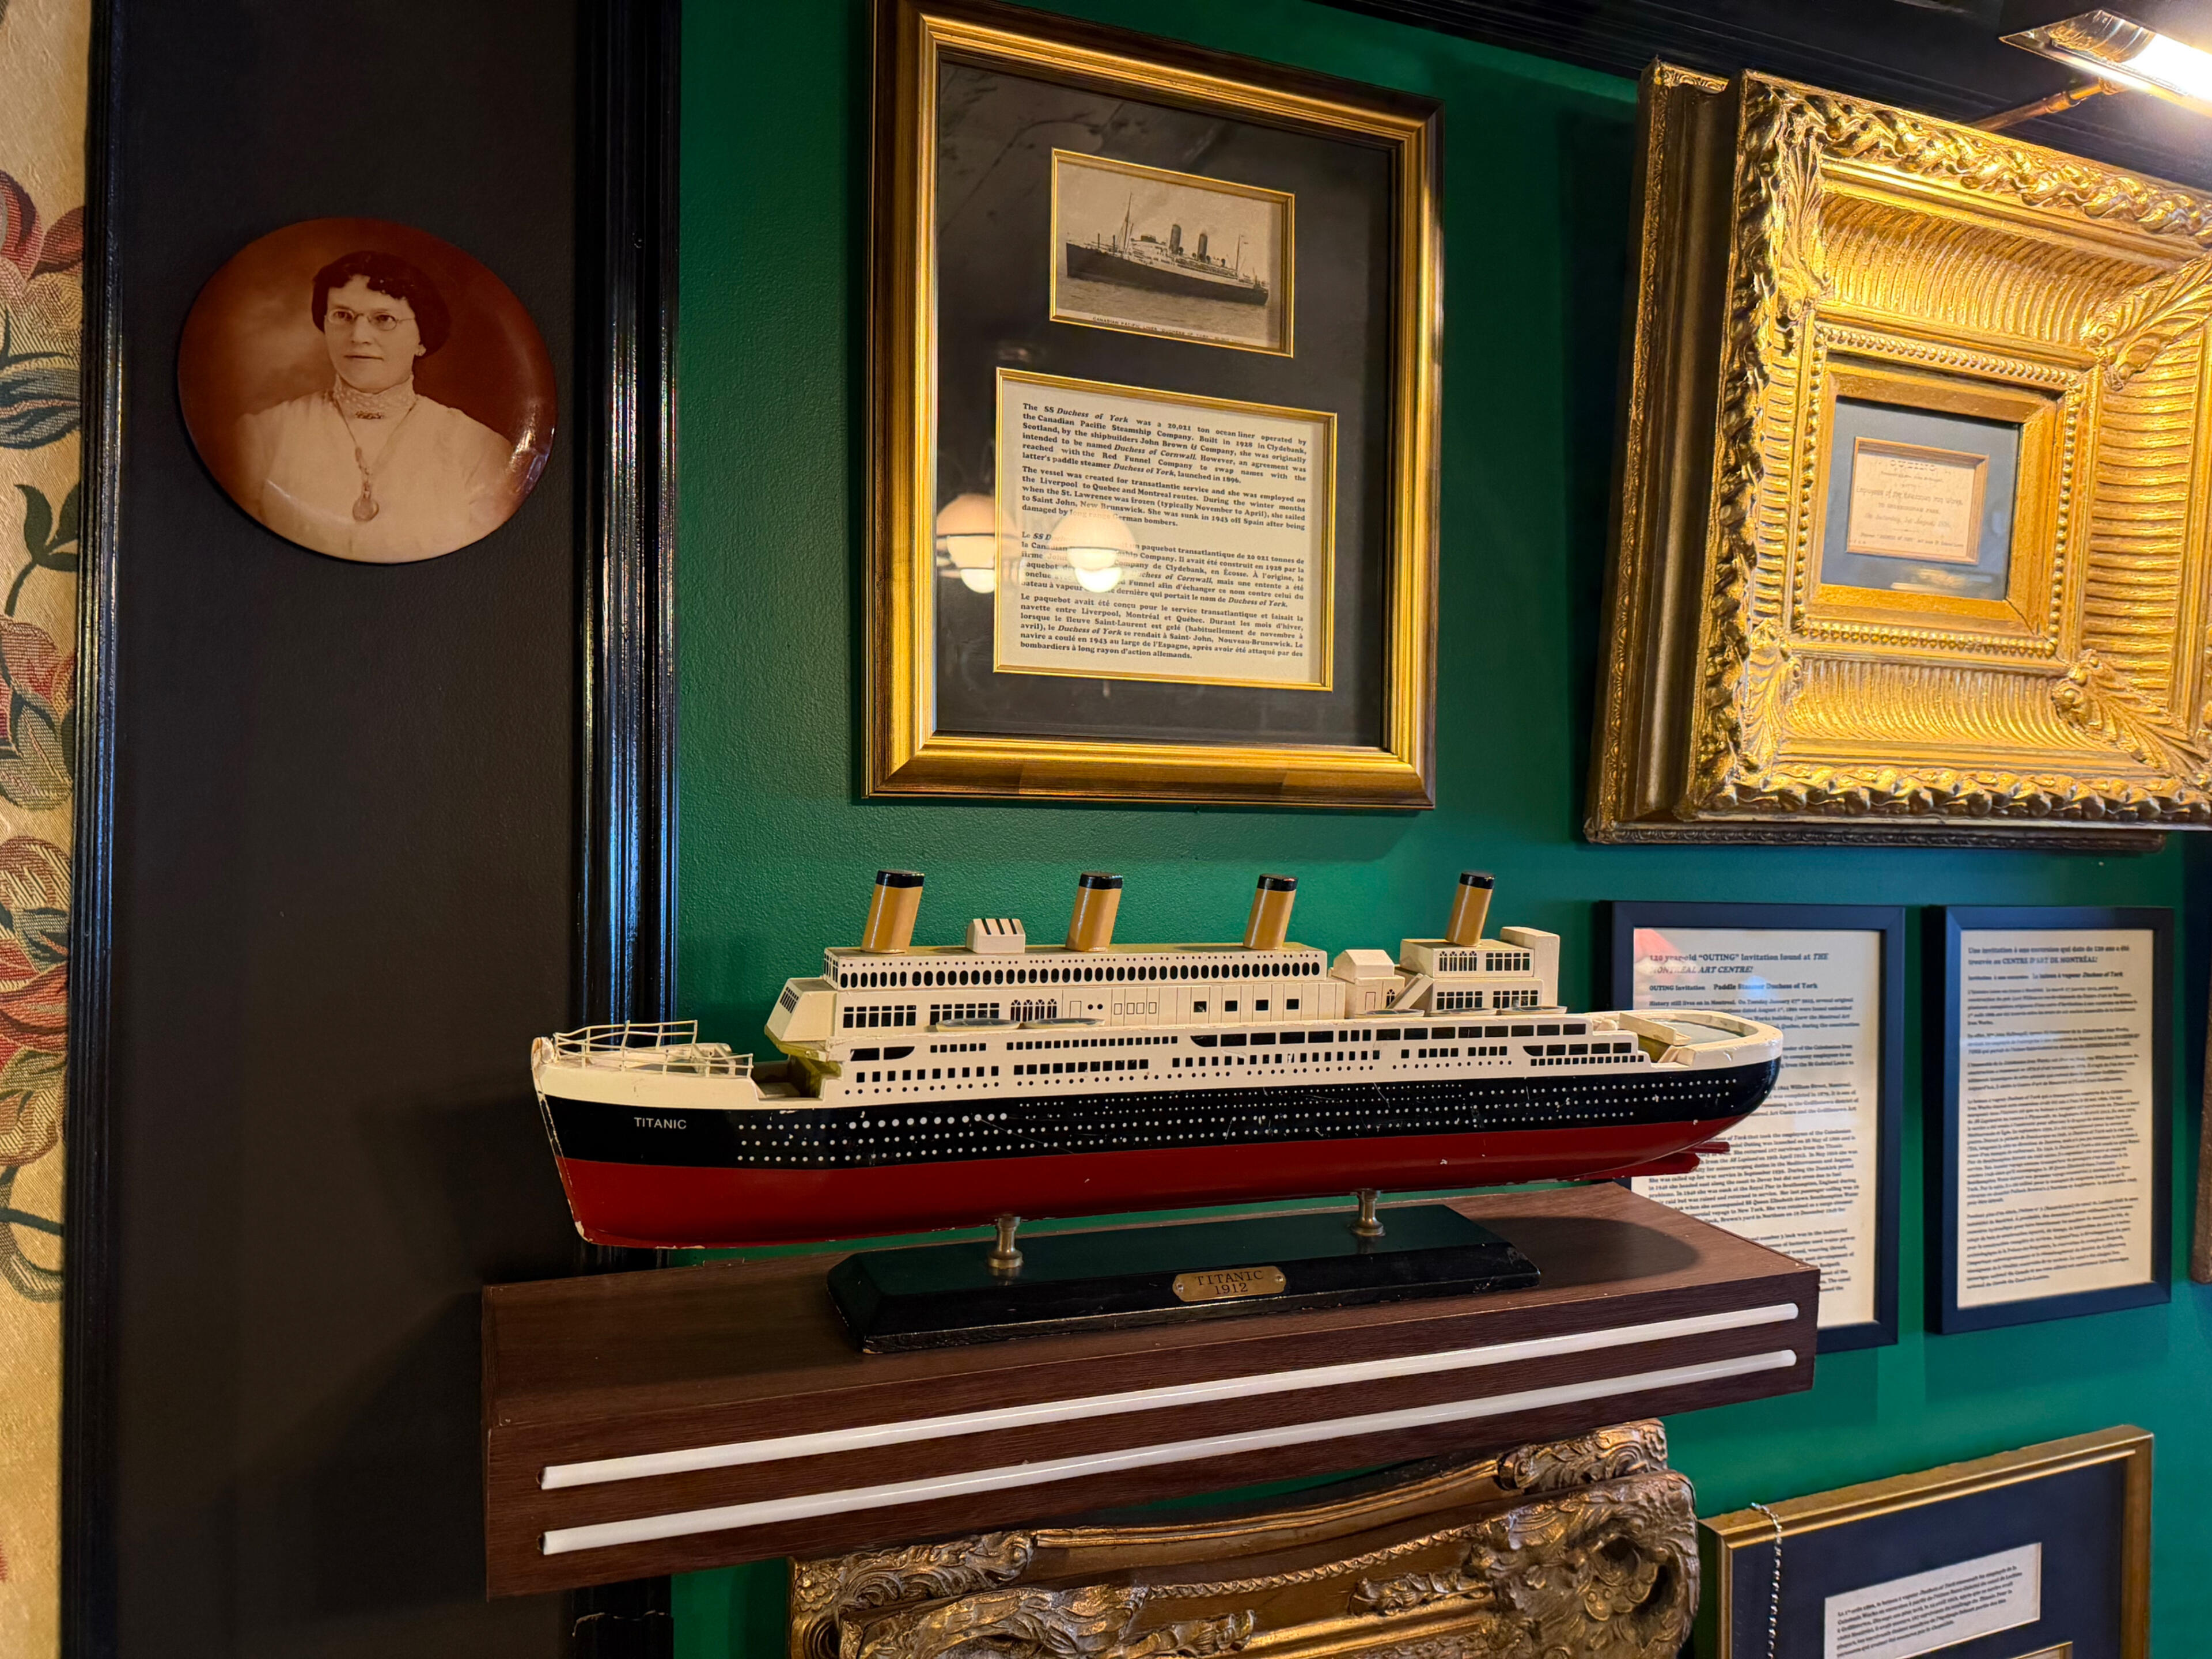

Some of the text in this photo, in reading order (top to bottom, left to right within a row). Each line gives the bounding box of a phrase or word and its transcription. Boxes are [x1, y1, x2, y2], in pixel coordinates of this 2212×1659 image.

[1022, 403, 1038, 411] The
[1044, 406, 1055, 414] SS
[1056, 407, 1089, 418] Duchess
[1109, 414, 1128, 423] York
[1215, 429, 1236, 437] ocean
[1237, 431, 1256, 439] liner
[1260, 435, 1293, 444] operated
[1298, 438, 1306, 446] by
[1022, 412, 1036, 421] the
[1037, 414, 1075, 426] Canadian
[1080, 420, 1107, 430] Pacific
[1111, 424, 1152, 437] Steamship
[1156, 430, 1194, 442] Company.
[1199, 435, 1218, 444] Built
[1266, 443, 1307, 455] Clydebank,
[1022, 422, 1060, 435] Scotland,
[1061, 427, 1071, 436] by
[1074, 429, 1088, 437] the
[1090, 431, 1138, 444] shipbuilders
[1139, 437, 1160, 446] John
[1162, 440, 1188, 449] Brown
[1200, 445, 1237, 457] Company,
[1271, 454, 1306, 464] originally
[1022, 432, 1058, 443] intended
[1073, 438, 1083, 446] be
[1086, 442, 1112, 450] named
[1113, 444, 1146, 454] Duchess
[1160, 449, 1197, 460] Cornwall.
[1200, 454, 1236, 466] However,
[1251, 461, 1289, 471] agreement
[1022, 444, 1054, 452] reached
[1061, 448, 1081, 456] with
[1102, 452, 1118, 460] Red
[1124, 454, 1151, 464] Funnel
[1157, 459, 1193, 471] Company
[1214, 467, 1234, 475] swap
[1052, 457, 1079, 465] paddle
[1080, 460, 1111, 469] steamer
[1112, 463, 1145, 473] Duchess
[1156, 468, 1176, 478] York,
[1177, 470, 1211, 480] launched
[1021, 465, 1037, 474] The
[1040, 469, 1064, 477] vessel
[1085, 475, 1114, 483] created
[1131, 479, 1180, 490] transatlantic
[1183, 486, 1209, 494] service
[1259, 494, 1294, 502] employed
[1022, 475, 1036, 483] the
[1040, 476, 1078, 488] Liverpool
[1092, 483, 1120, 493] Quebec
[1137, 488, 1172, 498] Montreal
[1203, 495, 1229, 506] During
[1249, 501, 1275, 509] winter
[1020, 632, 1046, 640] navire
[1121, 638, 1141, 647] large
[1248, 648, 1275, 656] attaqué
[1020, 641, 1070, 651] bombardiers
[1078, 645, 1095, 654] long
[1152, 650, 1192, 659] allemands.
[634, 1117, 687, 1130] TITANIC
[1195, 1270, 1264, 1286] TITANIC
[1214, 1282, 1248, 1295] 1912
